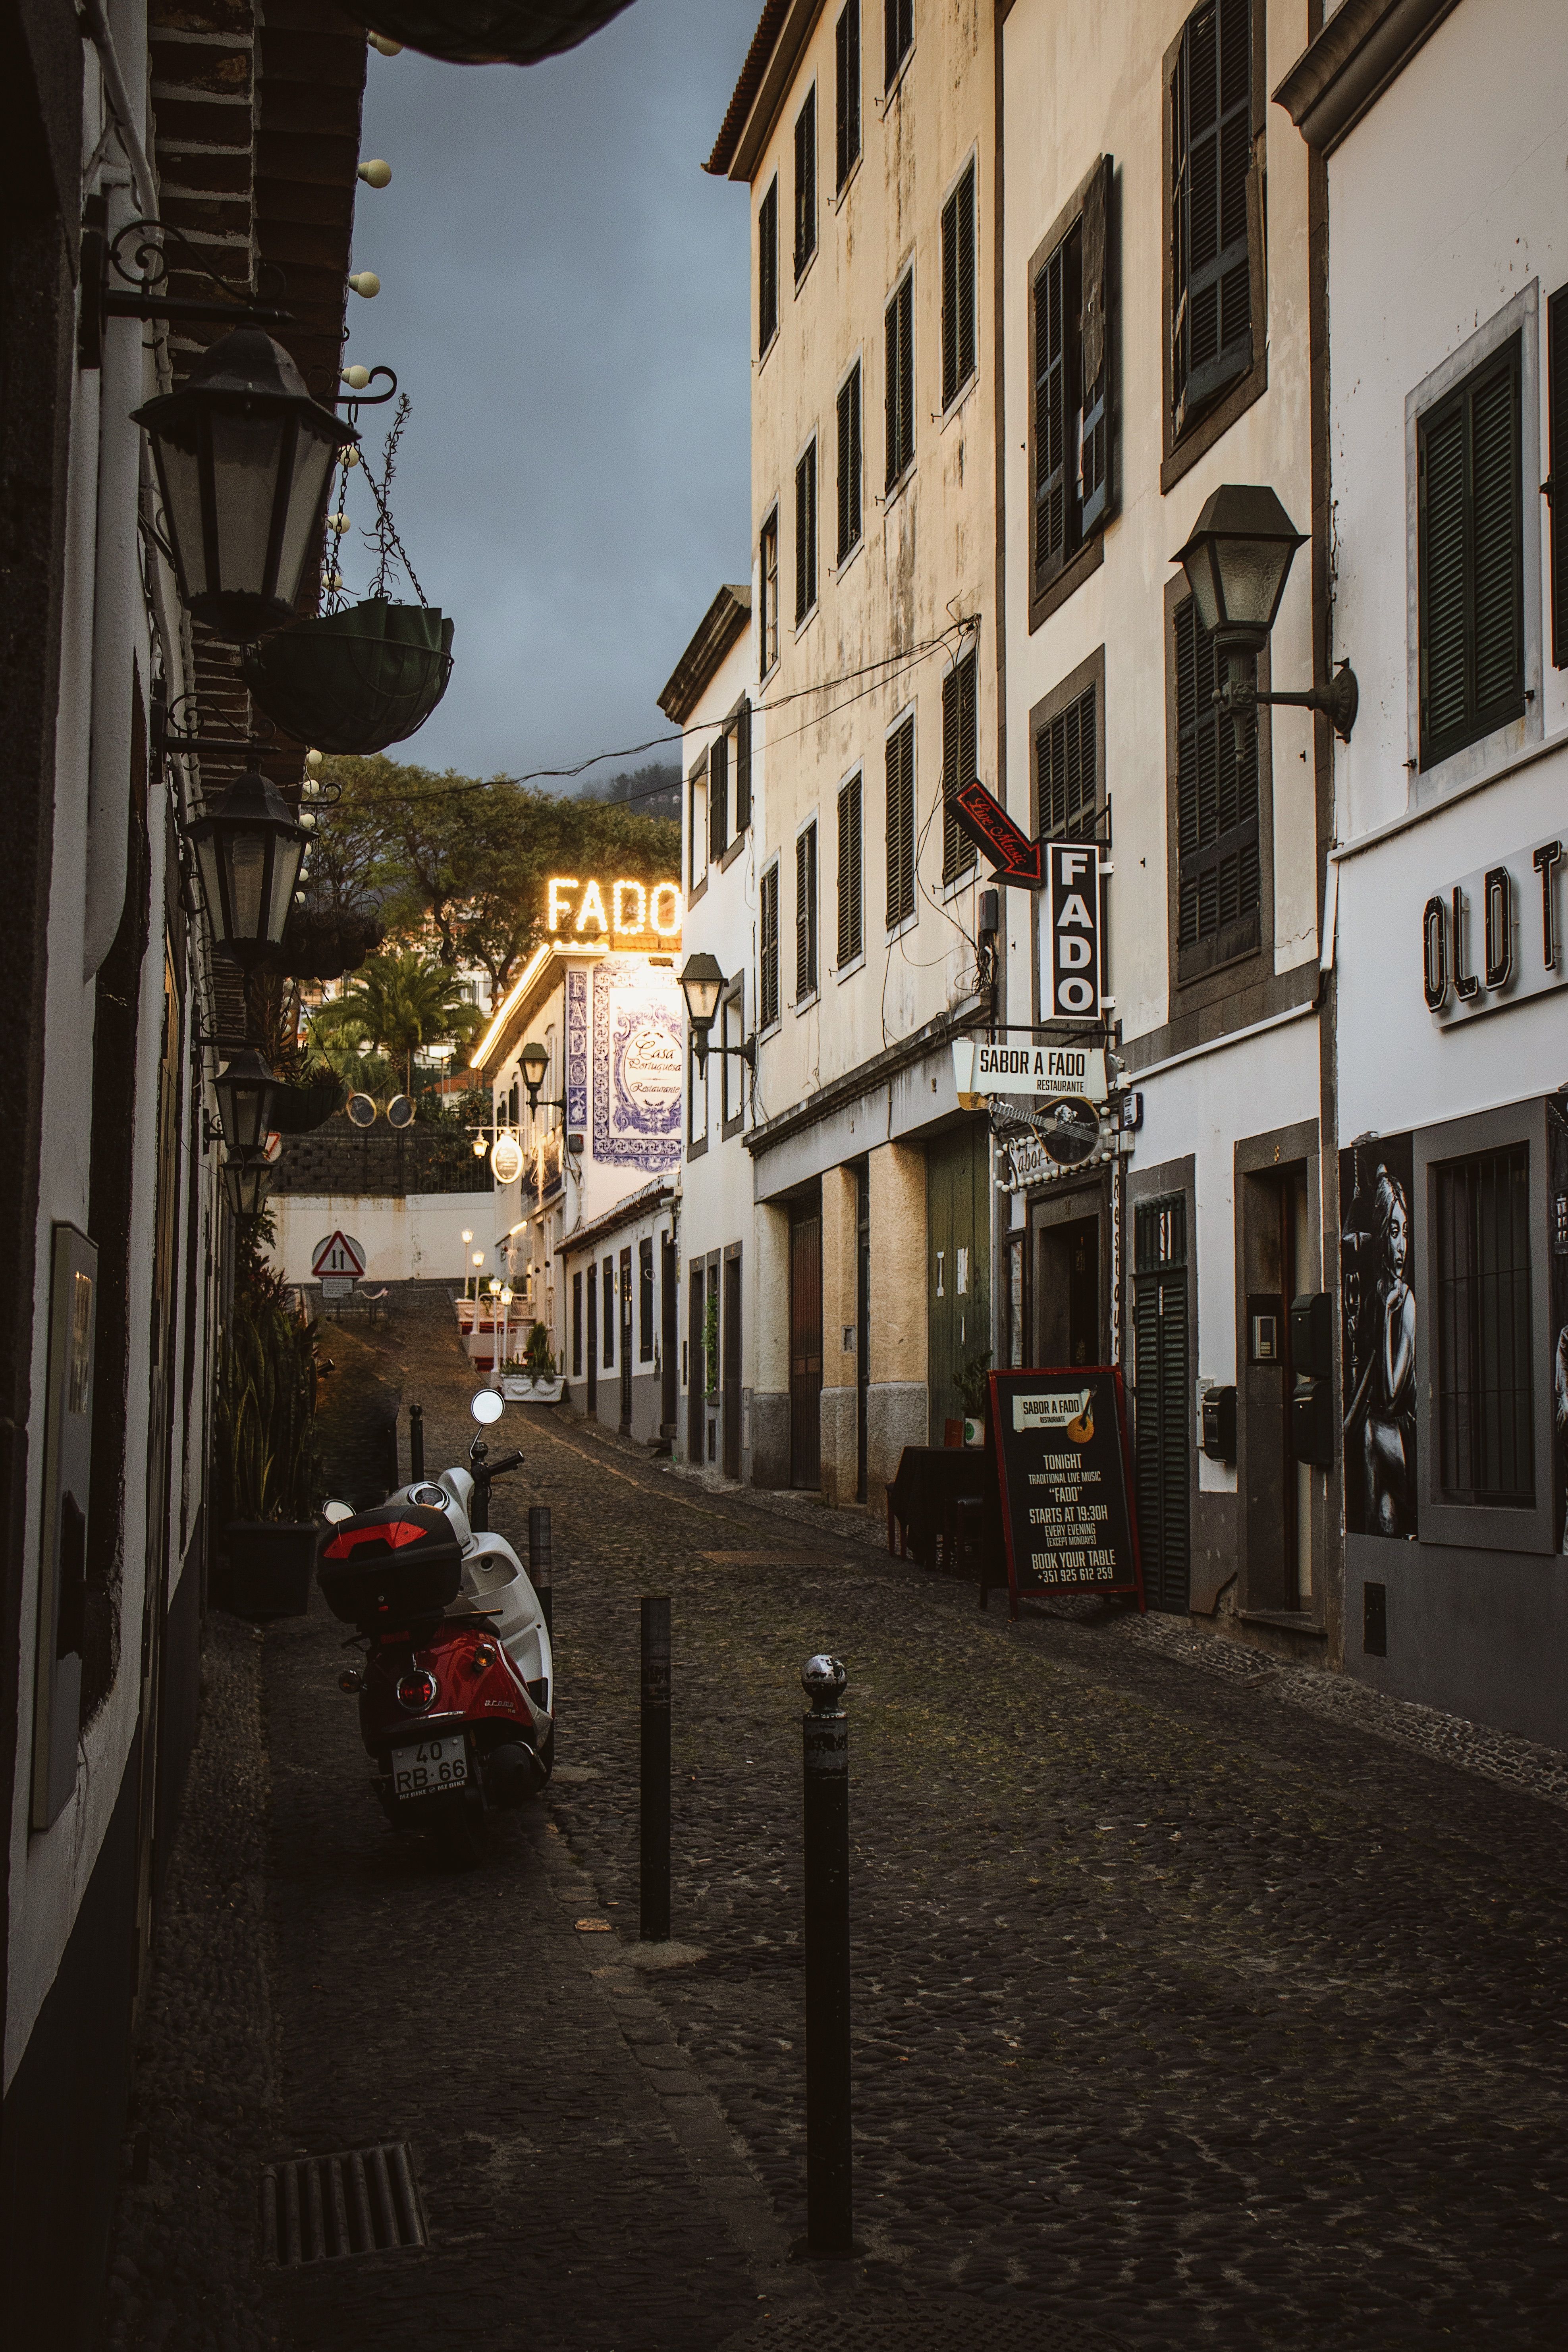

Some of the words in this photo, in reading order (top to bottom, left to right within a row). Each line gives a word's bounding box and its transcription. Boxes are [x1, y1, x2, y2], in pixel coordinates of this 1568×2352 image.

[966, 798, 993, 825] Live
[990, 827, 1026, 864] Music
[548, 878, 683, 935] FADO
[1057, 852, 1094, 1011] FADO
[1423, 866, 1512, 1014] OLD
[571, 974, 586, 1085] FADO
[636, 1040, 676, 1060] Casa
[627, 1057, 682, 1073] Portuguesa
[980, 1049, 1029, 1074] SABOR
[1034, 1052, 1043, 1074] A
[1049, 1053, 1085, 1076] FADO
[630, 1082, 680, 1093] Restaurante
[1038, 1080, 1084, 1092] RESTAURANTE
[1023, 1401, 1049, 1414] SABOR
[1052, 1401, 1057, 1413] A
[1059, 1400, 1079, 1413] FADO
[1043, 1453, 1082, 1470] TONIGHT
[1028, 1473, 1067, 1485] TRADITIONAL
[1067, 1472, 1081, 1483] LIVE
[1081, 1471, 1101, 1482] MUSIC
[1029, 1508, 1063, 1524] STARTS
[1065, 1506, 1074, 1522] AT
[1076, 1504, 1108, 1521] 19:30H
[1044, 1524, 1065, 1537] EVERY
[1067, 1523, 1096, 1536] EVENING
[1046, 1537, 1068, 1547] (EXCEPT
[1068, 1535, 1097, 1546] MONDAYS)
[1031, 1552, 1059, 1569] BOOK
[1059, 1551, 1086, 1568] YOUR
[1087, 1549, 1116, 1566] TABLE
[1037, 1570, 1058, 1583] +351
[1060, 1569, 1078, 1582] 925
[1079, 1567, 1095, 1581] 612
[1096, 1567, 1113, 1580] 259
[417, 1741, 442, 1763] 40
[411, 1789, 427, 1797] BIKE
[449, 1779, 465, 1789] BIKE
